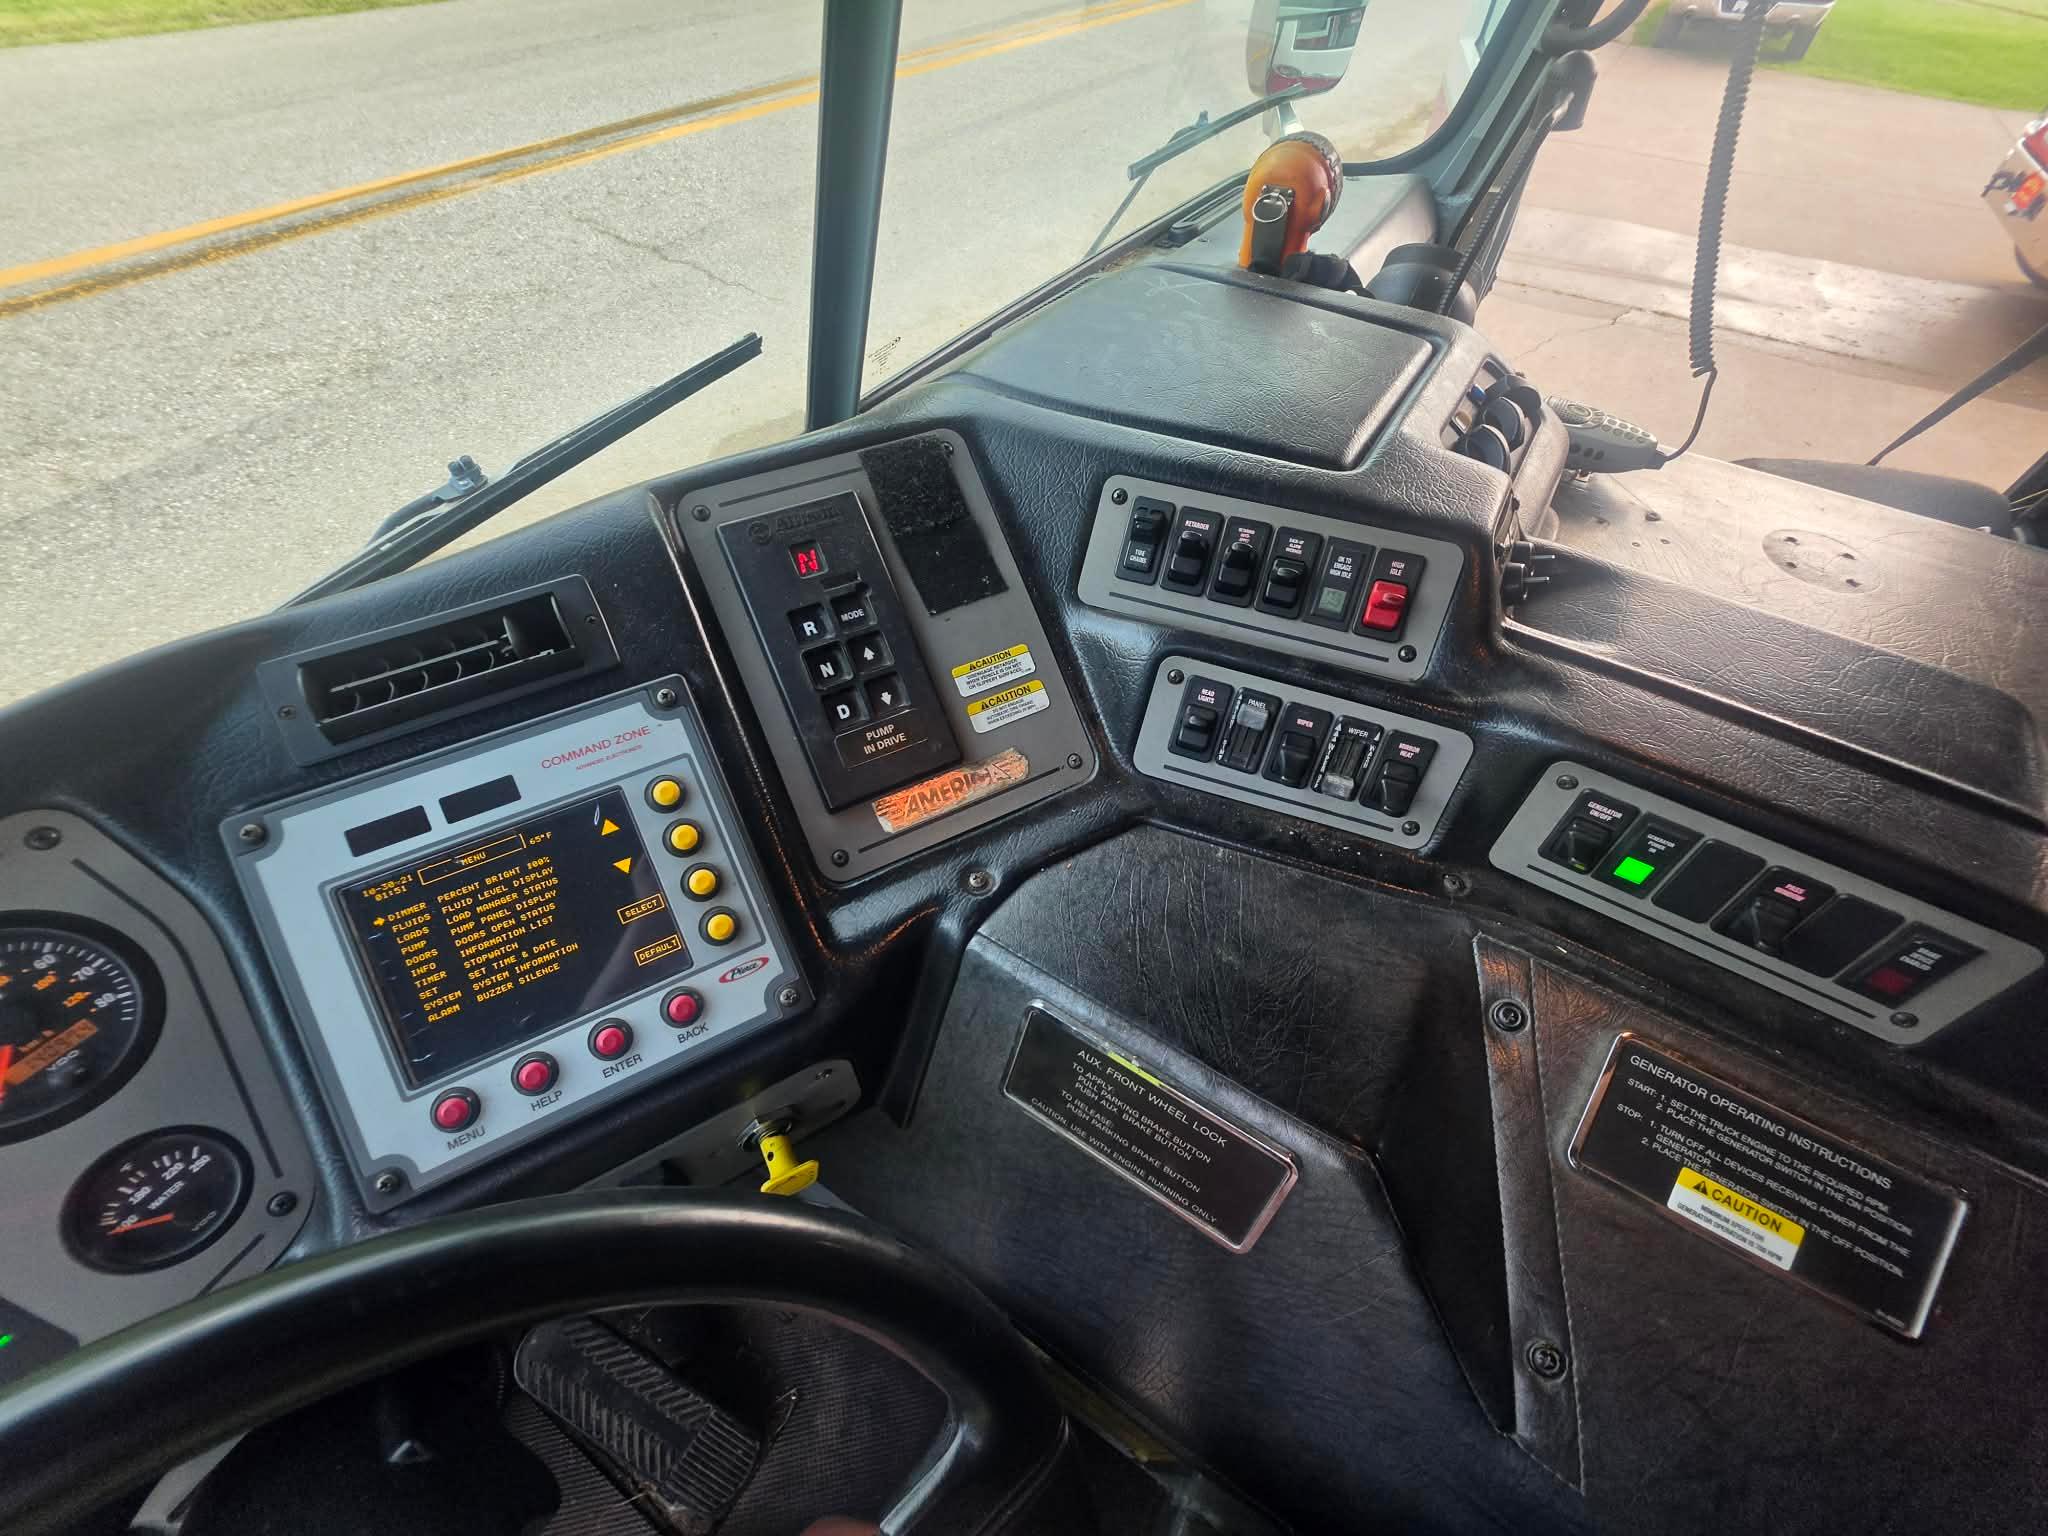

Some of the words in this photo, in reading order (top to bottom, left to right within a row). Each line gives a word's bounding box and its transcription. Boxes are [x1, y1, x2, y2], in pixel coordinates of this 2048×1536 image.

[1185, 520, 1210, 530] RETARDER
[1333, 562, 1352, 572] ENGAGE
[1341, 571, 1352, 579] IDLE
[1389, 568, 1403, 576] IDLE
[1391, 561, 1406, 569] HIGH
[841, 608, 866, 622] MODE
[803, 621, 818, 636] R
[820, 662, 835, 678] N
[975, 650, 1012, 668] CAUTION
[988, 685, 1031, 707] CAUTION
[1198, 694, 1215, 704] LIGHTS
[1201, 688, 1215, 697] HEAD
[837, 704, 850, 720] D
[1248, 699, 1267, 710] PANEL
[866, 724, 895, 741] PUMP
[1296, 718, 1314, 728] WIPER
[1348, 727, 1369, 738] WIPER
[541, 739, 612, 769] COMMAND
[615, 725, 651, 745] ZONE
[863, 744, 876, 755] IN
[876, 733, 907, 750] DRIVE
[1400, 750, 1415, 759] HEAT
[1588, 801, 1623, 819] GENERATOR
[1590, 809, 1613, 821] ON/OFF
[1647, 833, 1675, 848] GENERATOR
[461, 852, 486, 866] MENU
[375, 885, 407, 901] 01:51
[387, 902, 427, 922] DIMMER
[437, 882, 480, 903] PERCENT
[485, 866, 521, 885] BRIGHT
[527, 856, 550, 870] 100%
[392, 913, 431, 933] FLUIDS
[442, 898, 473, 914] FLUID
[478, 885, 509, 900] LEVEL
[513, 866, 554, 887] DISPLAY
[397, 927, 430, 944] LOADS
[446, 911, 471, 925] LOAD
[476, 893, 519, 914] MANAGER
[523, 877, 559, 896] STATUS
[625, 899, 657, 918] SELECT
[401, 940, 427, 955] PUMP
[450, 922, 475, 936] PUMP
[480, 909, 512, 924] PANEL
[516, 890, 556, 911] DISPLAY
[405, 949, 438, 967] DOORS
[455, 930, 486, 947] DOORS
[491, 918, 516, 933] OPEN
[520, 902, 556, 921] STATUS
[411, 962, 436, 977] INFO
[460, 926, 526, 958] INFORMATION
[530, 915, 554, 930] LIST
[639, 939, 678, 961] DEFAULT
[33, 954, 56, 970] 60
[414, 971, 447, 988] TIMER
[463, 942, 519, 969] STOPWATCH
[419, 986, 438, 1000] SET
[468, 967, 487, 980] SET
[492, 955, 517, 970] TIME
[532, 939, 558, 954] DATE
[72, 966, 95, 981] 70
[424, 990, 462, 1011] SYSTEM
[472, 970, 510, 991] SYSTEM
[514, 942, 579, 974] INFORMATION
[428, 1004, 460, 1022] ALARM
[476, 982, 514, 1003] BUZZER
[518, 962, 561, 985] SILENCE
[678, 1022, 710, 1045] BACK
[602, 1053, 643, 1079] ENTER
[1072, 1062, 1084, 1073] TO
[530, 1089, 563, 1112] HELP
[1061, 1090, 1073, 1101] TO
[1077, 1050, 1102, 1070] AUX.
[1106, 1067, 1146, 1095] FRONT
[1148, 1093, 1189, 1125] WHEEL
[1192, 1121, 1228, 1148] LOCK
[1075, 1082, 1099, 1101] PUSH
[1122, 1113, 1153, 1136] BRAKE
[1154, 1134, 1193, 1161] BUTTON
[1078, 1075, 1098, 1092] PULL
[1100, 1089, 1140, 1118] PARKING
[1140, 1115, 1173, 1139] BRAKE
[1173, 1135, 1212, 1163] BUTTON
[1630, 1055, 1708, 1099] GENERATOR
[1710, 1094, 1785, 1137] OPERATING
[1788, 1131, 1893, 1190] INSTRUCTIONS
[447, 1126, 487, 1151] MENU
[1066, 1102, 1090, 1121] PUSH
[1091, 1119, 1129, 1147] PARKING
[1131, 1144, 1161, 1169] BRAKE
[1163, 1166, 1201, 1193] BUTTON
[1627, 1078, 1657, 1098] START:
[1661, 1094, 1668, 1102] 1.
[1670, 1099, 1689, 1113] SET
[1690, 1108, 1708, 1122] THE
[1709, 1117, 1740, 1139] TRUCK
[1741, 1134, 1777, 1157] ENGINE
[1778, 1151, 1792, 1164] TO
[1793, 1160, 1811, 1175] THE
[1813, 1169, 1864, 1201] REQUIRED
[1655, 1133, 1712, 1168] GENERATOR.
[1655, 1102, 1664, 1111] 2.
[1666, 1107, 1696, 1127] PLACE
[1698, 1122, 1716, 1137] THE
[1716, 1133, 1773, 1166] GENERATOR
[1774, 1161, 1811, 1186] SWITCH
[1813, 1181, 1825, 1191] IN
[1825, 1186, 1846, 1203] THE
[1846, 1198, 1863, 1211] ON
[161, 1162, 186, 1180] 220
[1070, 1123, 1088, 1138] USE
[1089, 1136, 1111, 1154] WITH
[1112, 1151, 1146, 1177] ENGINE
[1147, 1175, 1189, 1206] RUNNING
[1191, 1204, 1217, 1223] ONLY
[1616, 1103, 1643, 1122] STOP:
[1649, 1120, 1657, 1129] 1.
[1660, 1124, 1686, 1143] TURN
[1685, 1138, 1706, 1151] OFF
[1705, 1149, 1722, 1162] ALL
[1723, 1158, 1765, 1183] DEVICES
[1765, 1179, 1818, 1211] RECEIVING
[1819, 1206, 1857, 1230] POWER
[1856, 1225, 1889, 1247] FROM
[1888, 1239, 1912, 1258] THE
[147, 1180, 185, 1210] WATER
[1640, 1137, 1650, 1146] 2.
[1652, 1142, 1682, 1162] PLACE
[1683, 1157, 1702, 1171] THE
[1702, 1168, 1760, 1201] GENERATOR
[1760, 1198, 1796, 1220] SWITCH
[1811, 1223, 1832, 1240] THE
[1831, 1235, 1853, 1250] OFF
[1711, 1189, 1783, 1232] CAUTION
